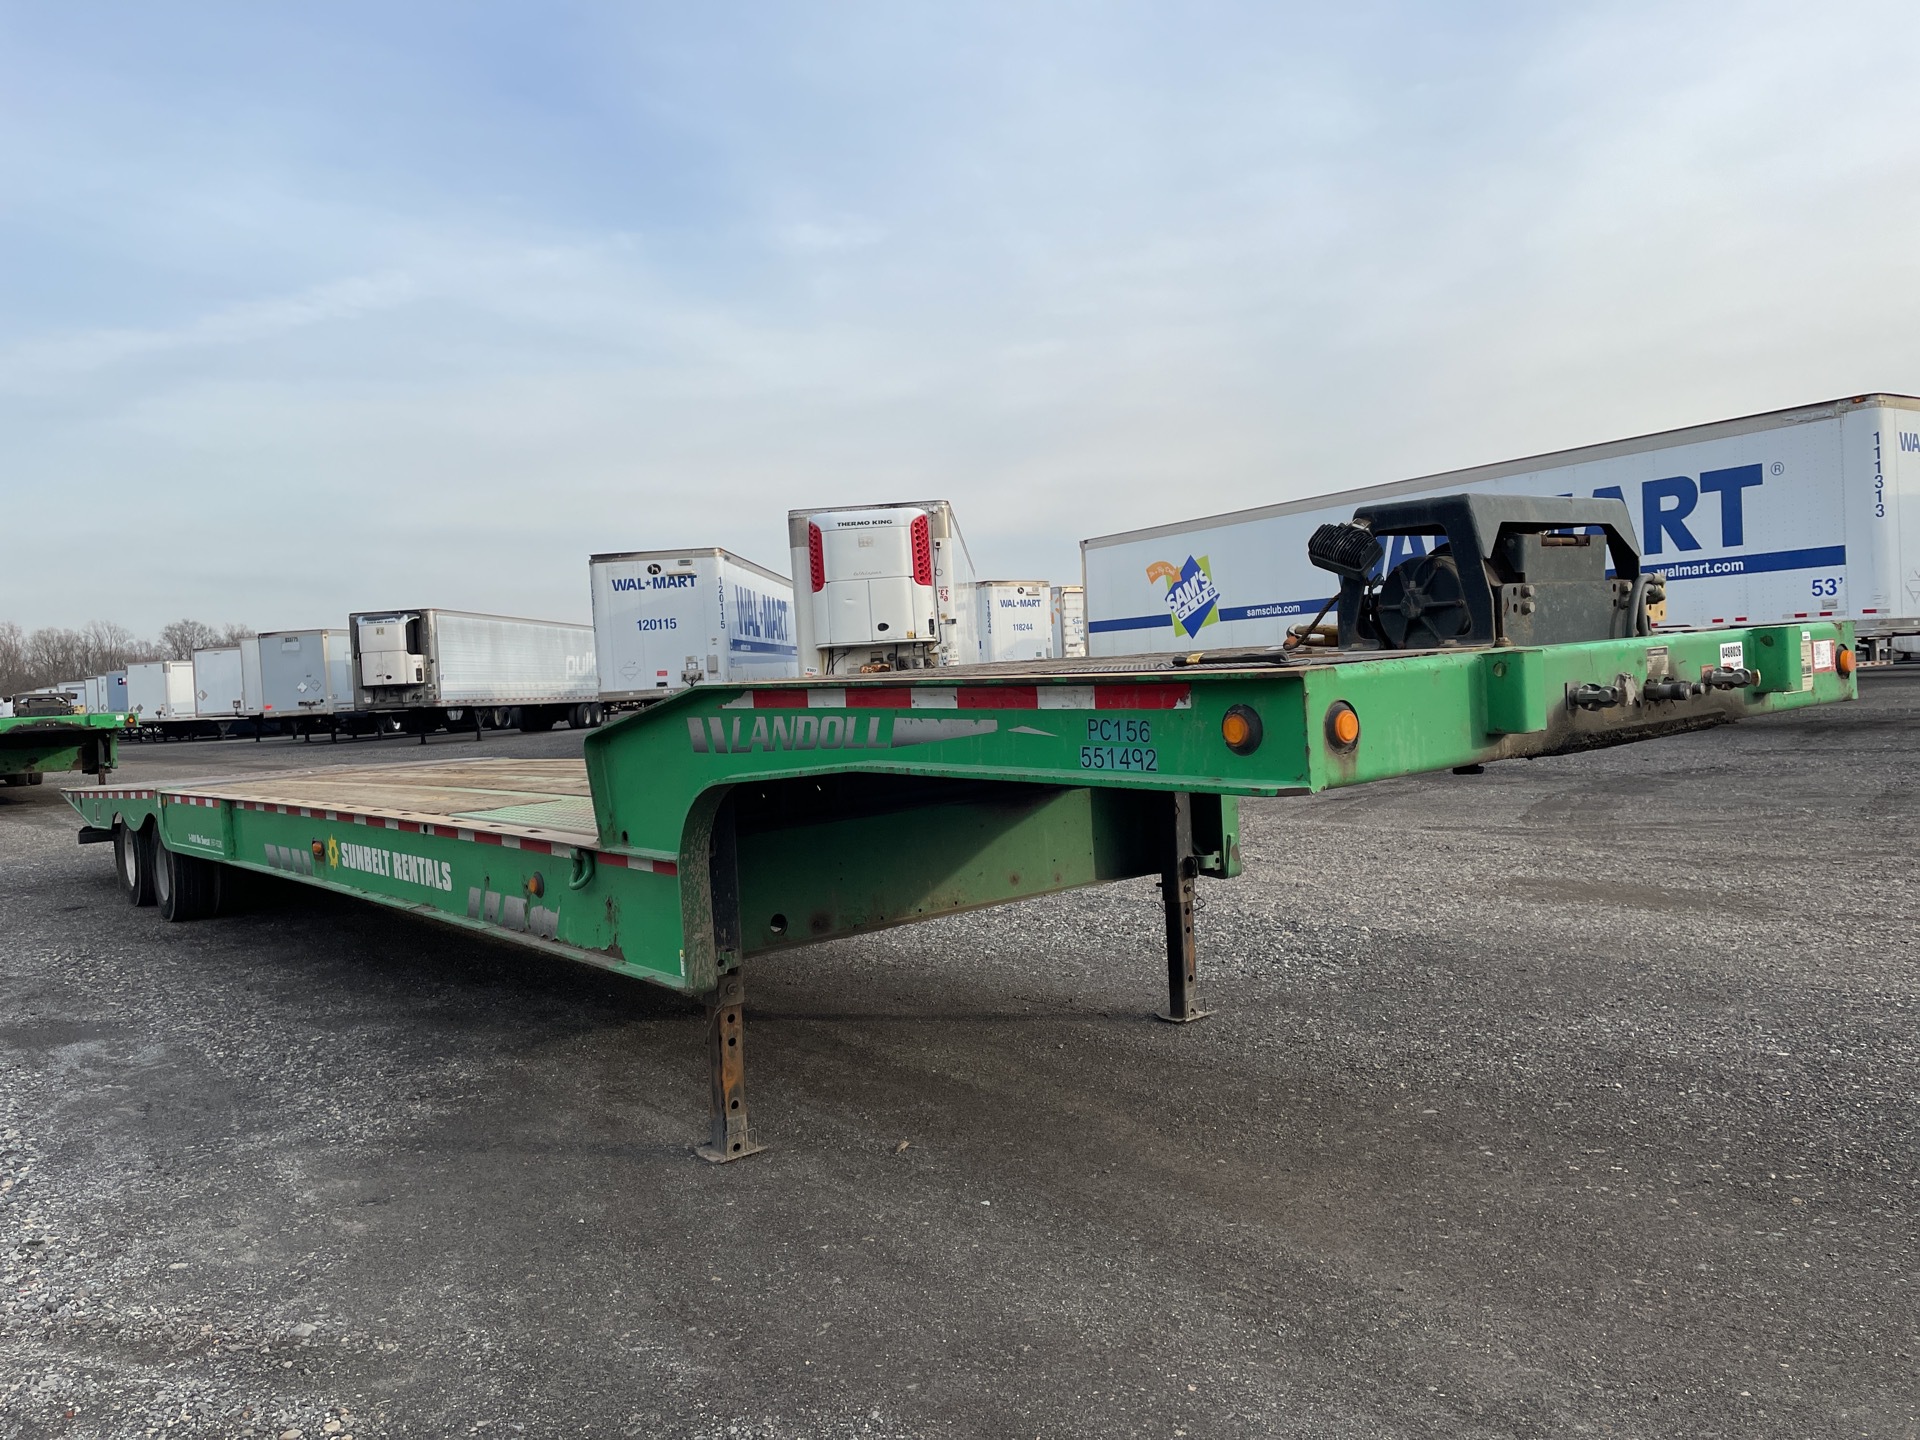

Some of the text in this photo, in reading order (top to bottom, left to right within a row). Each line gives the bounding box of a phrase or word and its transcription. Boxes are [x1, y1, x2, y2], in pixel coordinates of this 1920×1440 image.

[1873, 431, 1885, 518] 111313
[1165, 569, 1211, 613] SAM'S
[1177, 587, 1216, 620] CLUB
[636, 617, 677, 631] 120115
[1246, 603, 1301, 617] samsclub.com
[1012, 623, 1033, 631] 118244
[731, 715, 891, 754] LANDOLL
[1087, 718, 1151, 743] PC156
[1081, 746, 1157, 772] 551492
[340, 842, 453, 892] SUNBELT RENTALS
